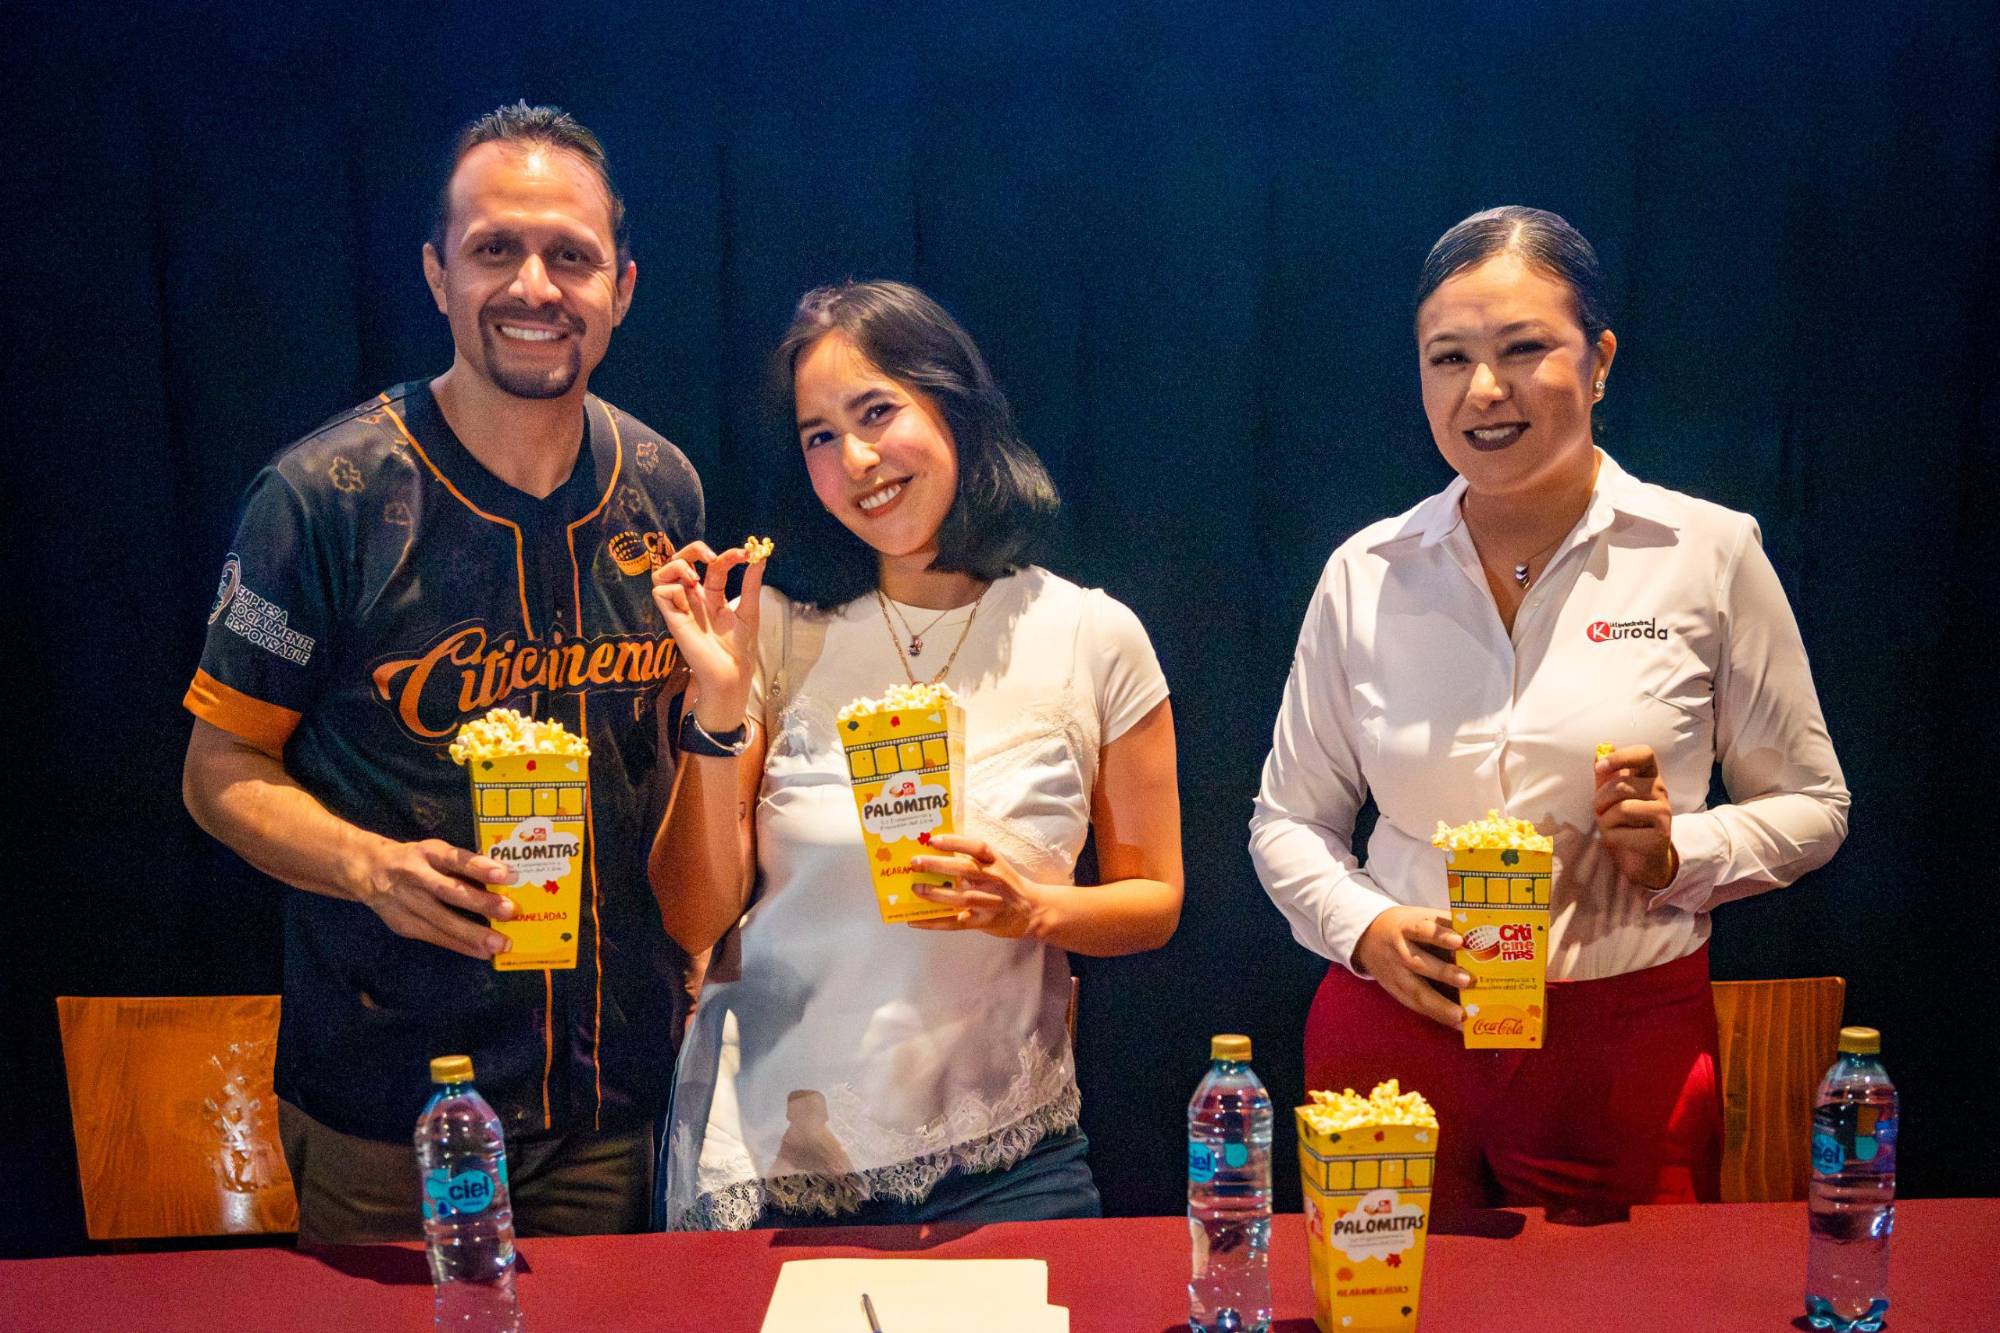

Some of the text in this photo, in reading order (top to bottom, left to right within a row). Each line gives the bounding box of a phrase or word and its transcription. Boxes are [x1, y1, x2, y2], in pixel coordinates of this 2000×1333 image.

[236, 584, 289, 625] EMPRESA
[231, 599, 316, 652] SOCIALMENTE
[1588, 617, 1668, 642] Kuroda
[225, 612, 311, 666] RESPONSABLE
[863, 793, 949, 819] PALOMITAS
[490, 842, 580, 861] PALOMITAS
[1499, 923, 1532, 942] Citi
[1501, 941, 1534, 951] cine
[1502, 950, 1535, 961] mas
[448, 1176, 490, 1200] ciel
[1333, 1214, 1425, 1235] PALOMITAS
